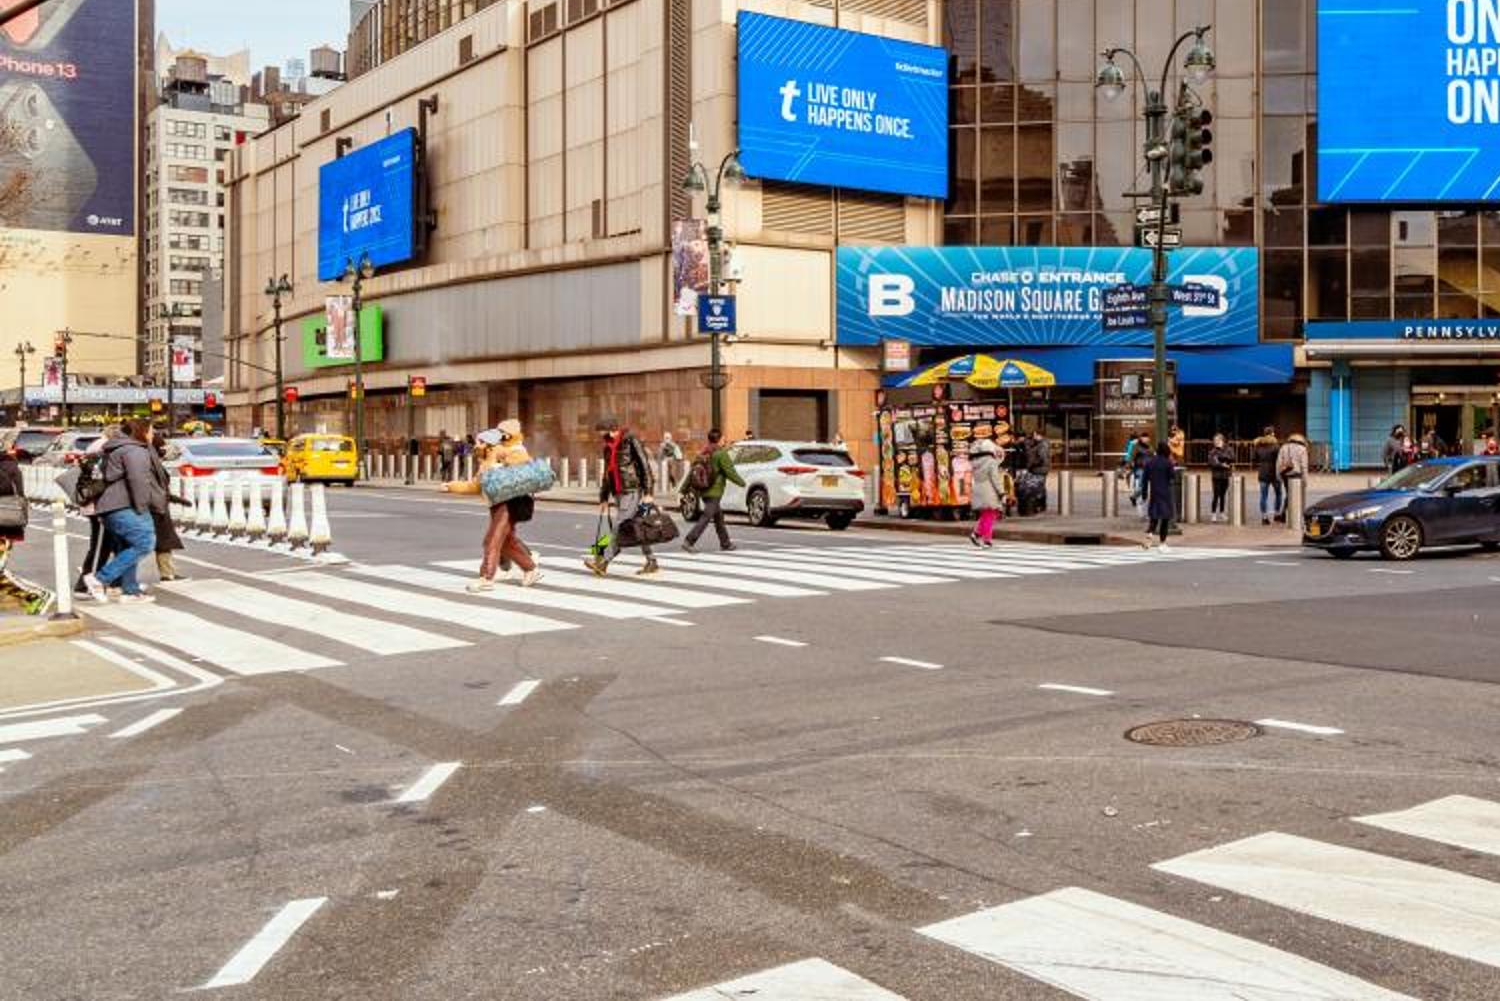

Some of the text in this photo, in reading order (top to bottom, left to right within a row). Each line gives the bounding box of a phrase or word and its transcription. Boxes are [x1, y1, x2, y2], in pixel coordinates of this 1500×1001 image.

[807, 82, 877, 112] LIVE ONLY
[807, 105, 915, 140] HAPPENS ONCE.
[971, 272, 1126, 284] CHASE ENTRANCE
[868, 273, 915, 316] B
[941, 286, 1016, 312] MADISON
[1021, 286, 1083, 313] SQUARE
